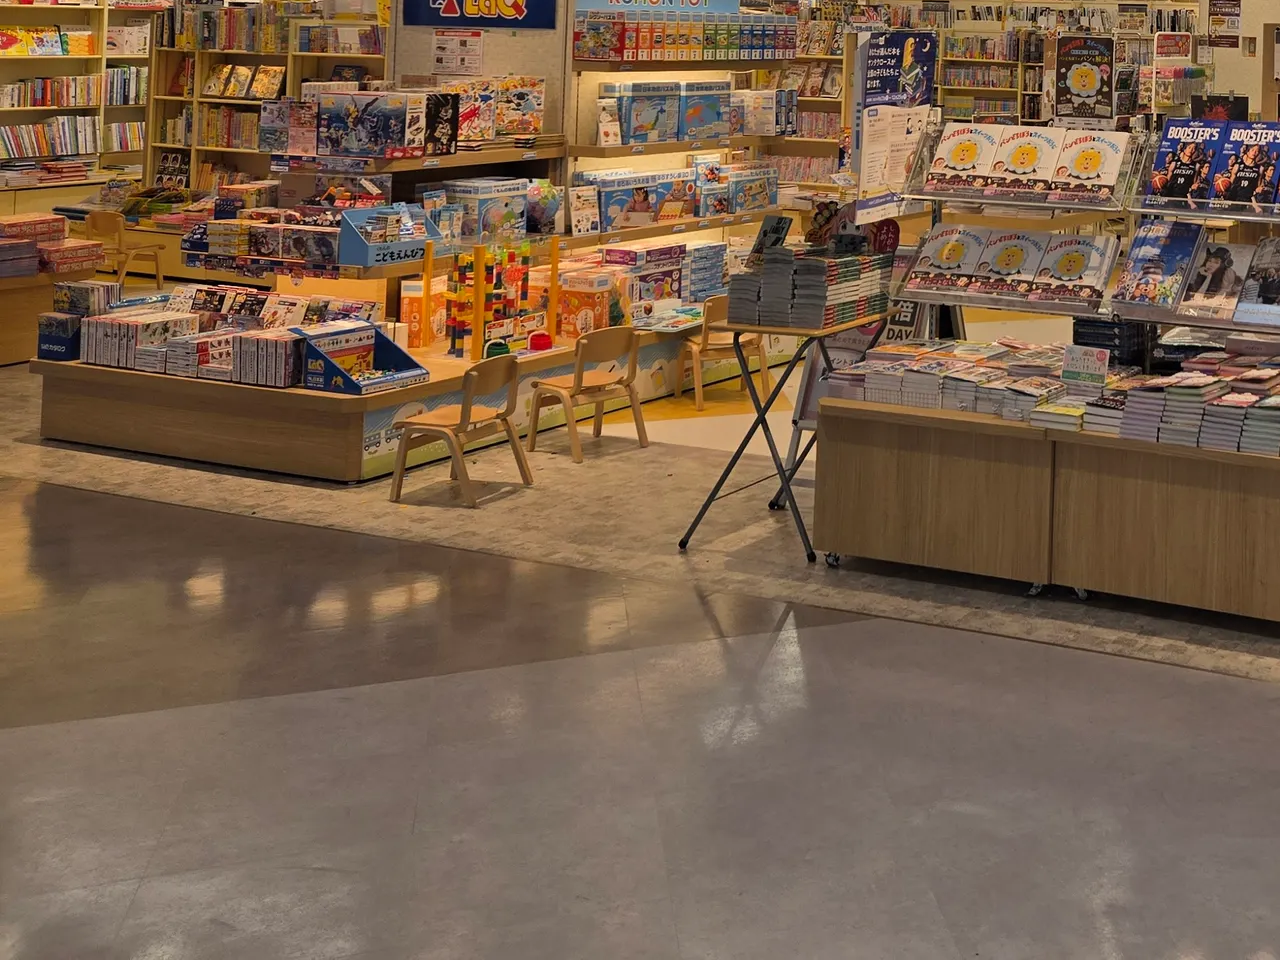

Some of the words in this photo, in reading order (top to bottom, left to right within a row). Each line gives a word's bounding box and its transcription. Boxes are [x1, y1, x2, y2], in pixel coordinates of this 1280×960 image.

[1167, 126, 1221, 141] BOOSTER'S
[375, 247, 425, 263] こどもえんぴつ
[886, 327, 913, 341] DAY
